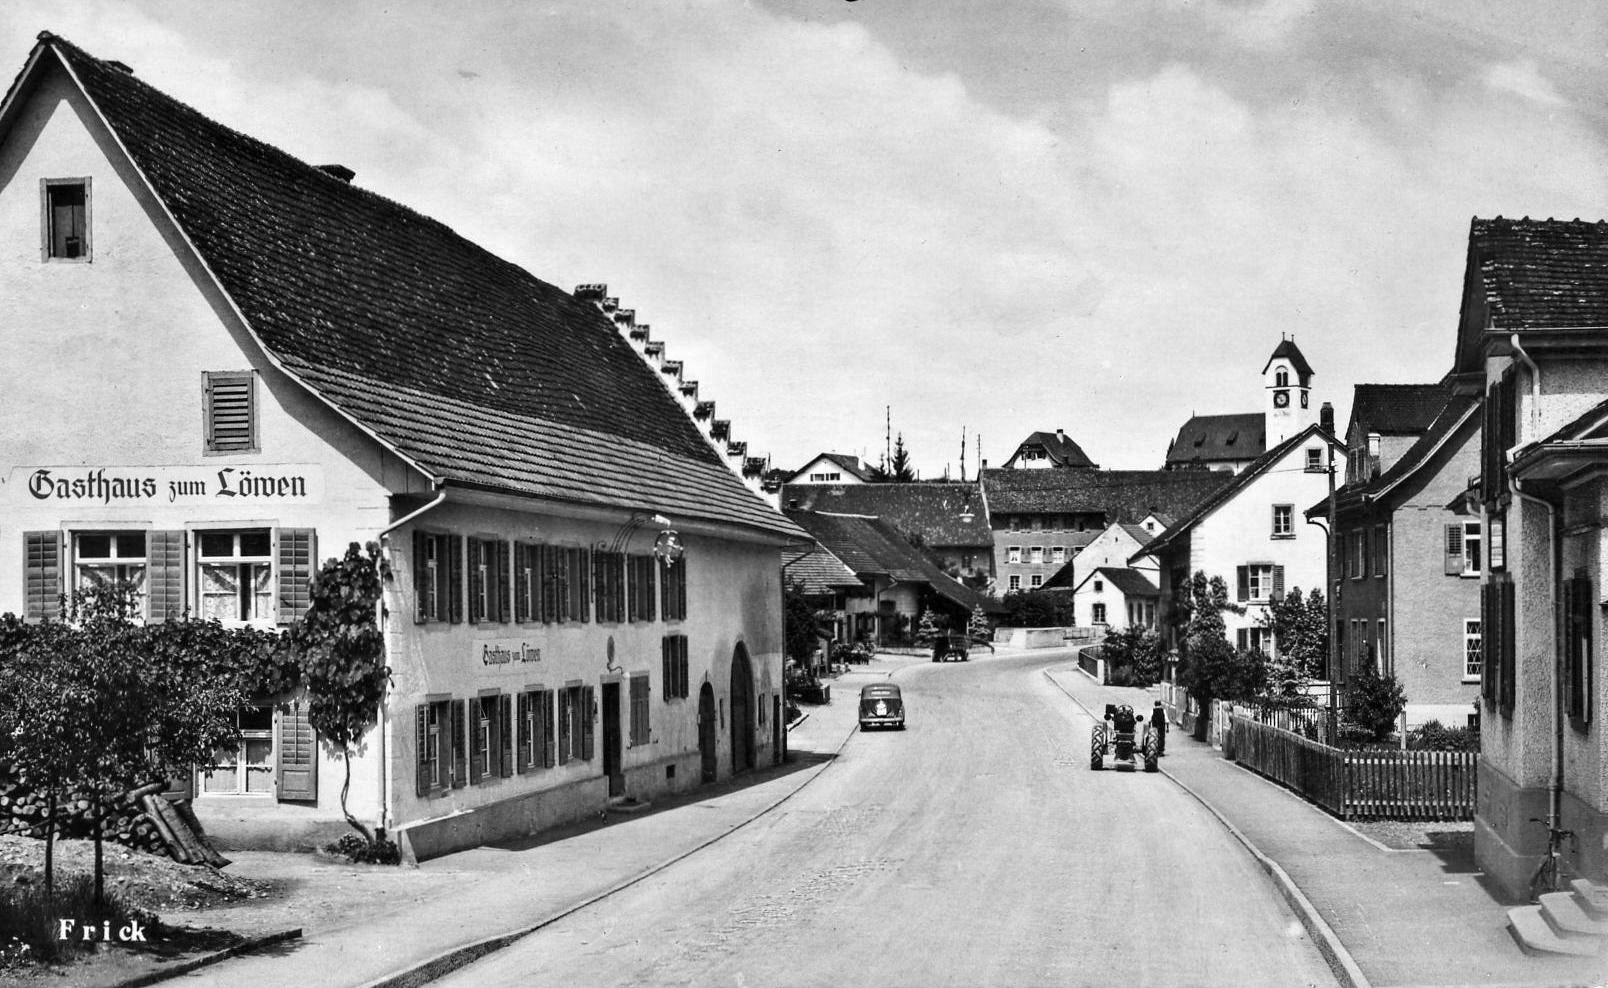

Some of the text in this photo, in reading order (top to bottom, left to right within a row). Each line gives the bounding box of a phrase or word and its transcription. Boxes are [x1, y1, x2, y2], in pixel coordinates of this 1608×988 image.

[28, 467, 307, 504] Gasthaus zum Löwen
